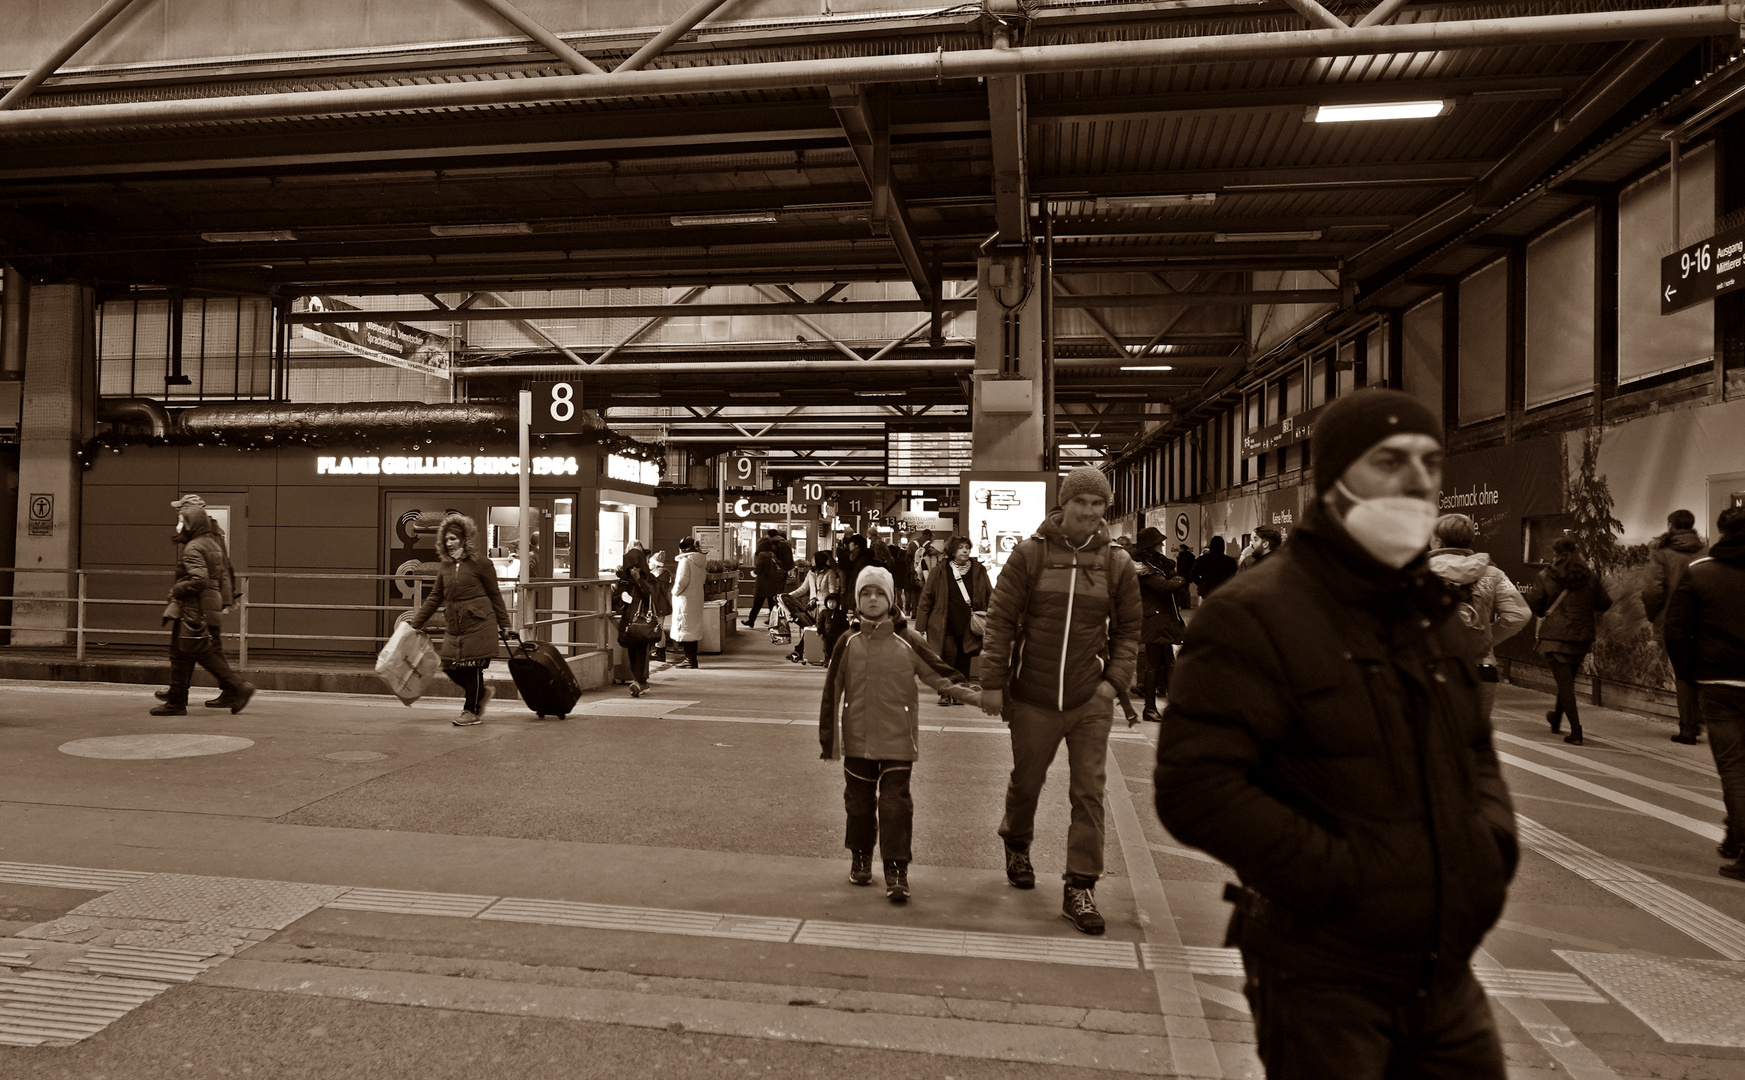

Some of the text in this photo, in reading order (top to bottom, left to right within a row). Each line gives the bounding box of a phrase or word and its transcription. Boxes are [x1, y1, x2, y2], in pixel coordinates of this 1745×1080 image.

[1716, 241, 1744, 259] Ausgang
[1681, 244, 1711, 279] 9-16
[1716, 257, 1742, 275] Mittlerer
[550, 382, 575, 422] 8
[381, 456, 471, 474] GRILLING
[473, 456, 530, 474] SINC
[737, 457, 752, 480] 9
[802, 483, 822, 501] 10
[1437, 482, 1499, 510] Geschmack ohne
[849, 500, 861, 512] 11
[867, 509, 880, 520] 12
[885, 517, 896, 526] 13
[897, 521, 907, 530] 14
[907, 525, 916, 533] 15
